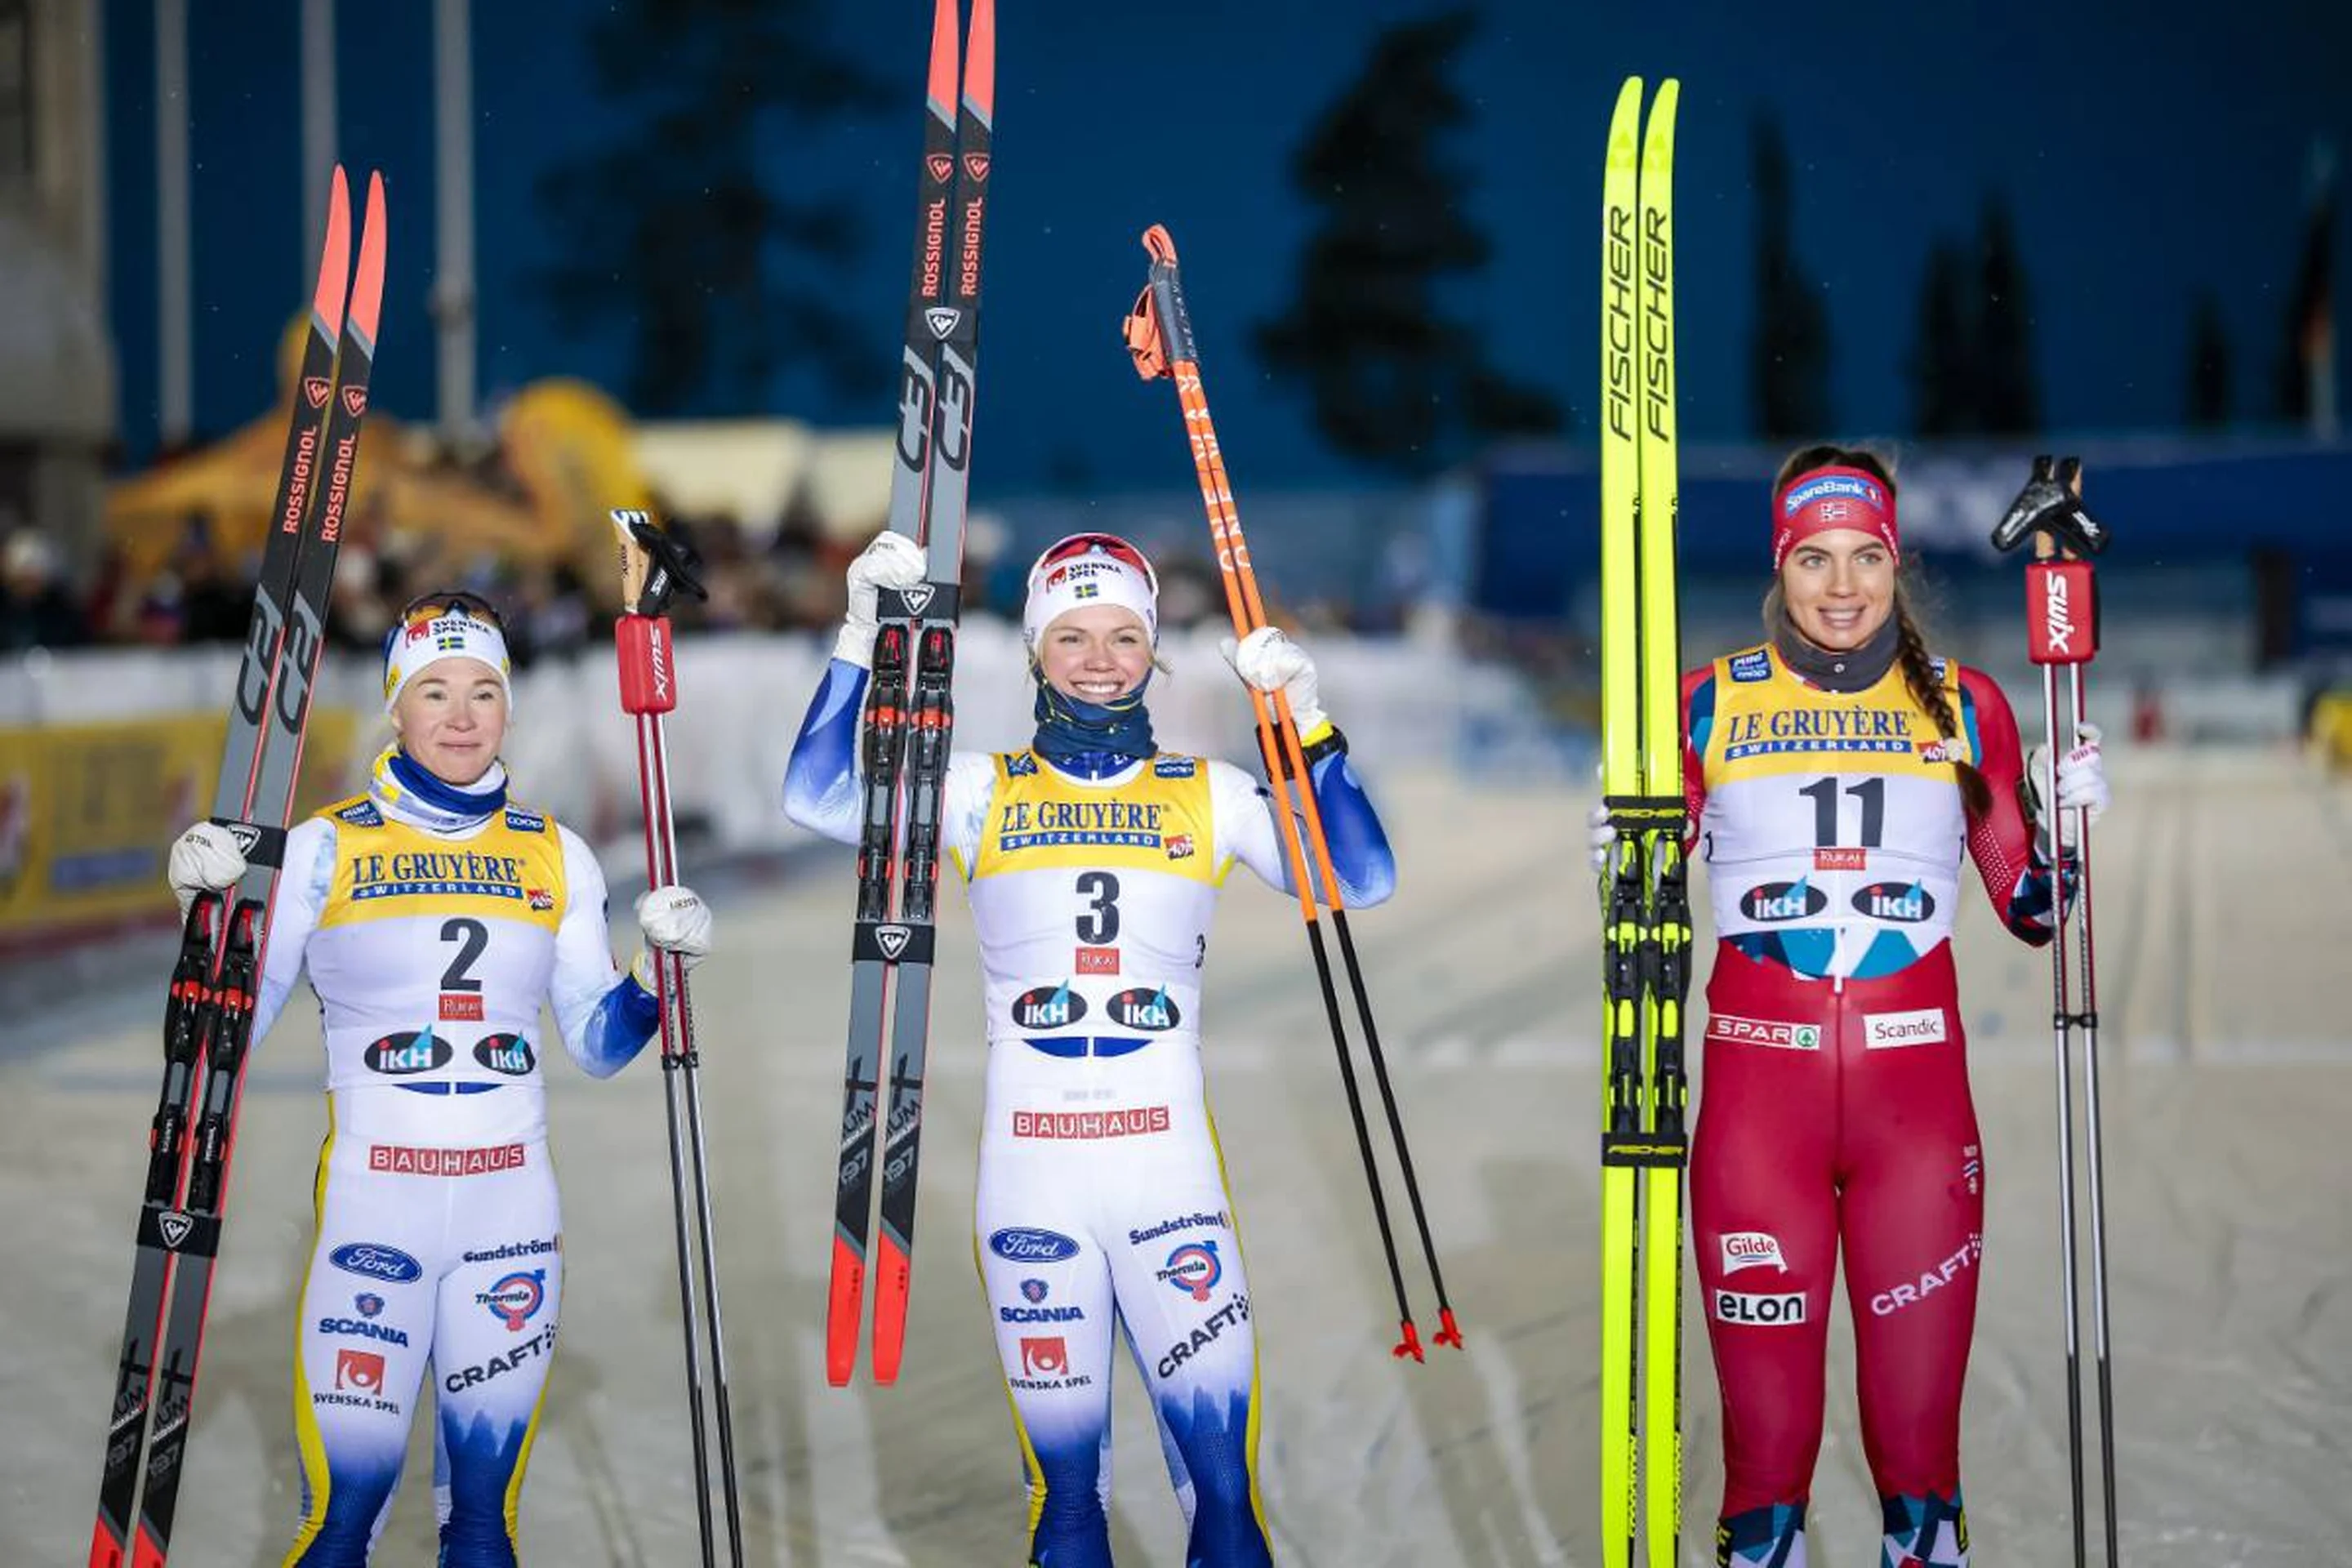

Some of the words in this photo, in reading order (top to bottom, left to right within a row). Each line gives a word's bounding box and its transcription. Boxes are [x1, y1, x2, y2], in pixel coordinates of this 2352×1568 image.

[923, 198, 946, 296] ROSSIGNOL
[960, 197, 983, 296] ROSSIGNOL
[1609, 204, 1632, 443] FISCHER
[1646, 206, 1669, 443] FISCHER
[283, 425, 317, 534] ROSSIGNOL
[321, 433, 356, 542] ROSSIGNOL
[1728, 711, 1763, 742] LE
[1770, 705, 1912, 737] GRUYÈRE
[1731, 740, 1904, 758] SWITZERLAND
[1001, 802, 1031, 833] LE
[1038, 798, 1162, 831] GRUYÈRE
[1798, 777, 1885, 848] 11
[1006, 832, 1156, 848] SWITZERLAND
[353, 855, 385, 884] LE
[393, 850, 522, 884] GRUYÈRE
[358, 883, 517, 898] SWITZERLAND
[1076, 871, 1120, 945] 3
[1755, 896, 1806, 920] IKH
[1872, 896, 1923, 920] IKH
[440, 918, 488, 991] 2
[1024, 1004, 1069, 1026] IKH
[1123, 1004, 1169, 1027] IKH
[1875, 1018, 1938, 1040] Scandic
[1717, 1020, 1792, 1043] SPAR
[379, 1048, 433, 1071] IKH
[491, 1048, 528, 1071] IKH
[1015, 1108, 1168, 1136] BAUHAUS
[372, 1146, 523, 1173] BAUHAUS
[1129, 1212, 1224, 1246] Sundström
[463, 1237, 555, 1263] Sundström
[1002, 1231, 1059, 1258] Ford
[1726, 1236, 1775, 1257] Gilde
[346, 1247, 404, 1276] Ford
[1870, 1245, 1971, 1316] CRAFT
[1000, 1306, 1085, 1323] SCANIA
[318, 1317, 409, 1348] SCANIA
[1158, 1306, 1240, 1379] CRAFT
[445, 1333, 544, 1394] CRAFT
[1009, 1378, 1062, 1390] SVENSKA
[1065, 1375, 1093, 1389] SPEL
[313, 1393, 372, 1409] SVENSKA
[375, 1399, 400, 1415] SPEL
